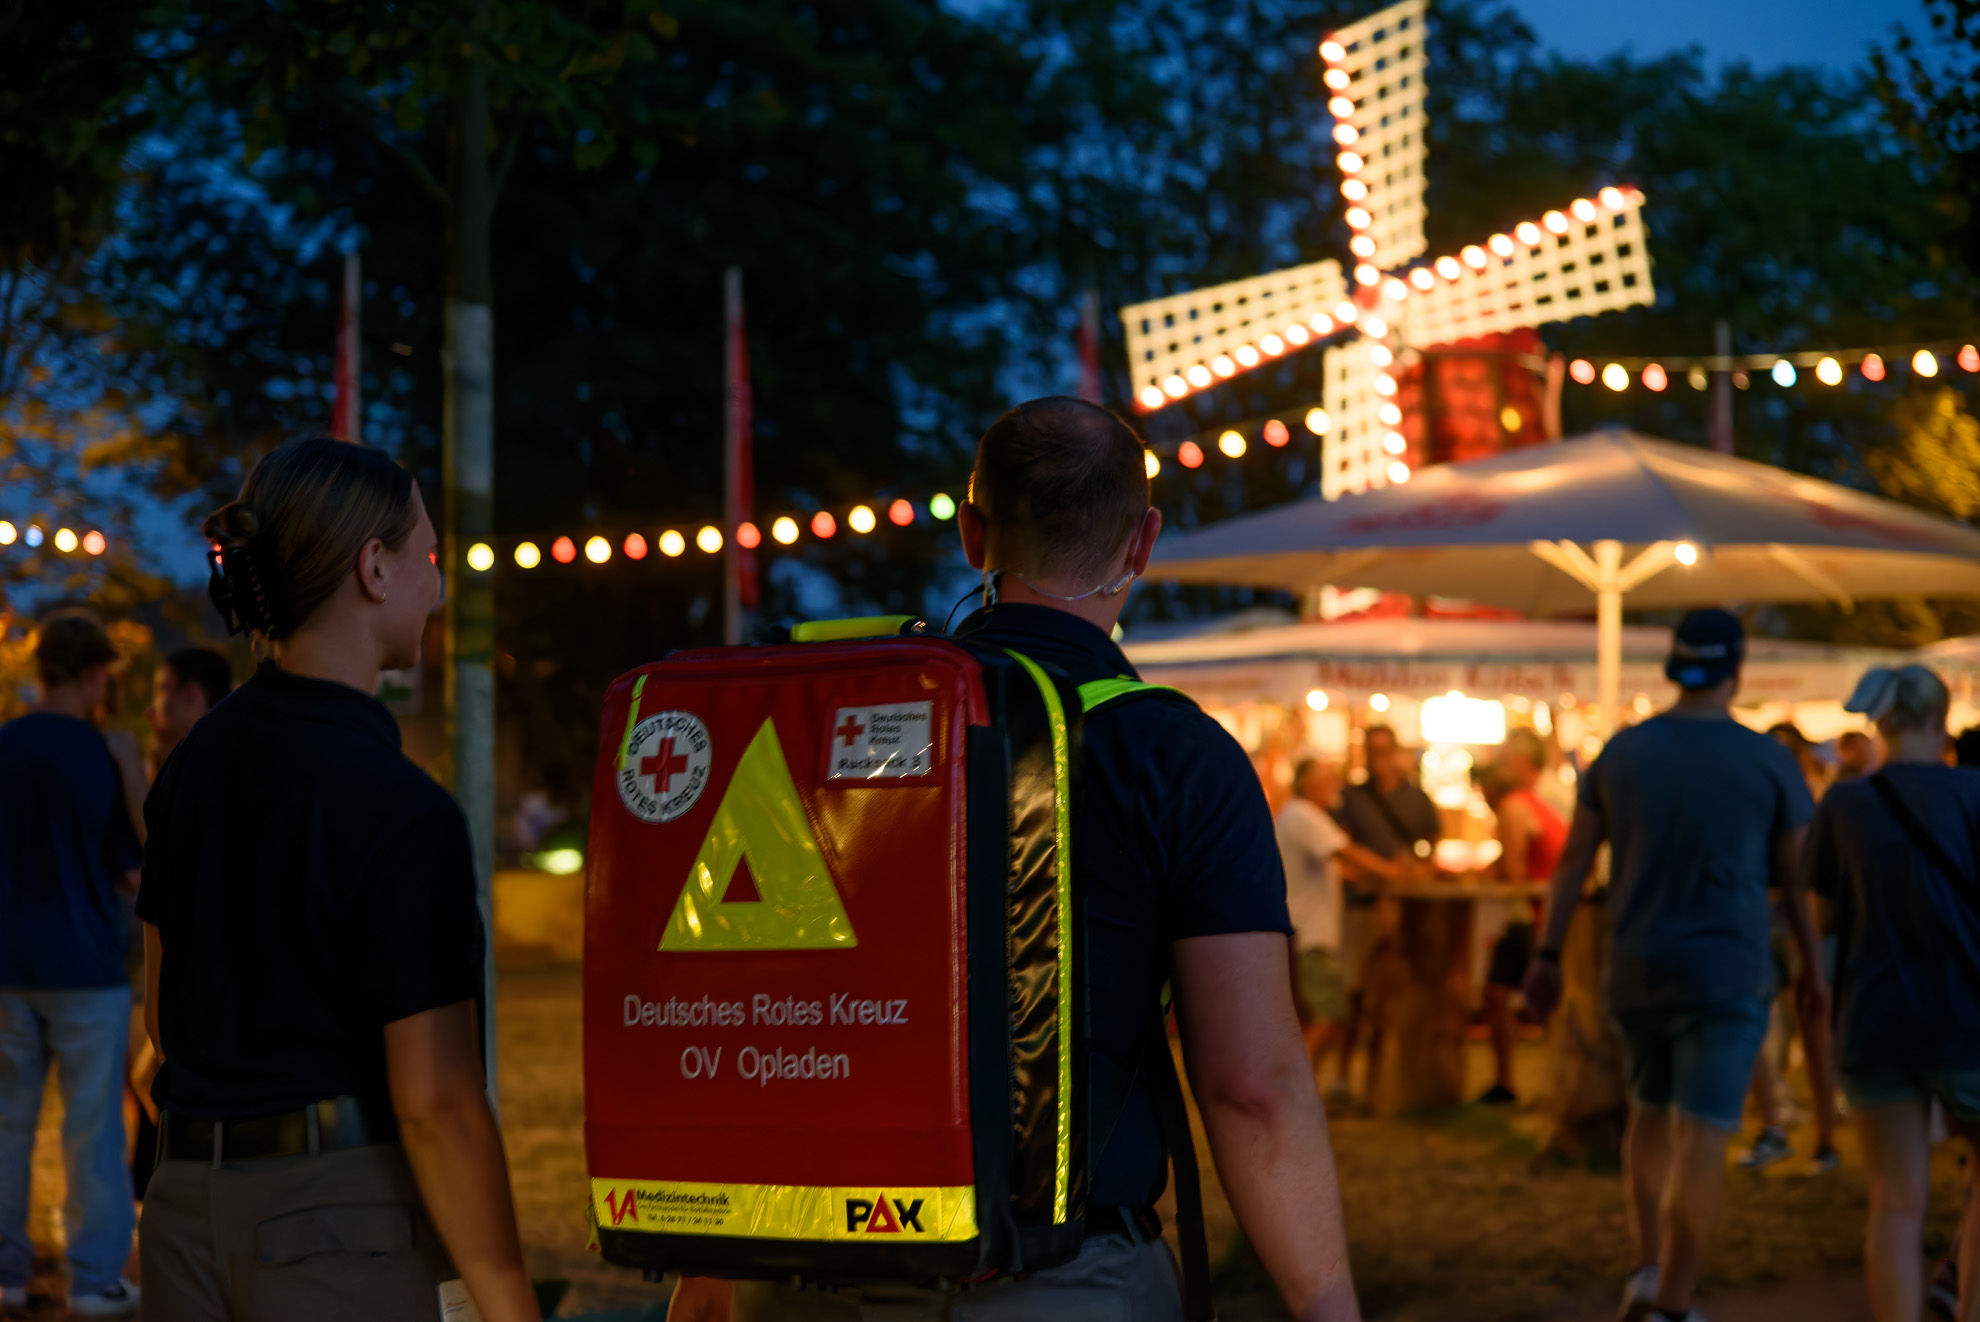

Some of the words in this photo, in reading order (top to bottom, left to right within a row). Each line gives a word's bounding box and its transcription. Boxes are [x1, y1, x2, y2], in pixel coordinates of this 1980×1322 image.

[628, 717, 708, 756] DEUTSCHES
[868, 735, 901, 745] Kreuz
[870, 724, 902, 734] Rotes
[622, 768, 657, 815] ROTES
[661, 765, 708, 814] KREUZ
[623, 994, 746, 1027] Deutsches
[752, 993, 823, 1026] Rotes
[830, 992, 909, 1025] Kreuz
[680, 1046, 722, 1080] OV
[737, 1046, 850, 1087] Opladen
[637, 1189, 730, 1206] Medizintechnik
[846, 1191, 926, 1233] PAX
